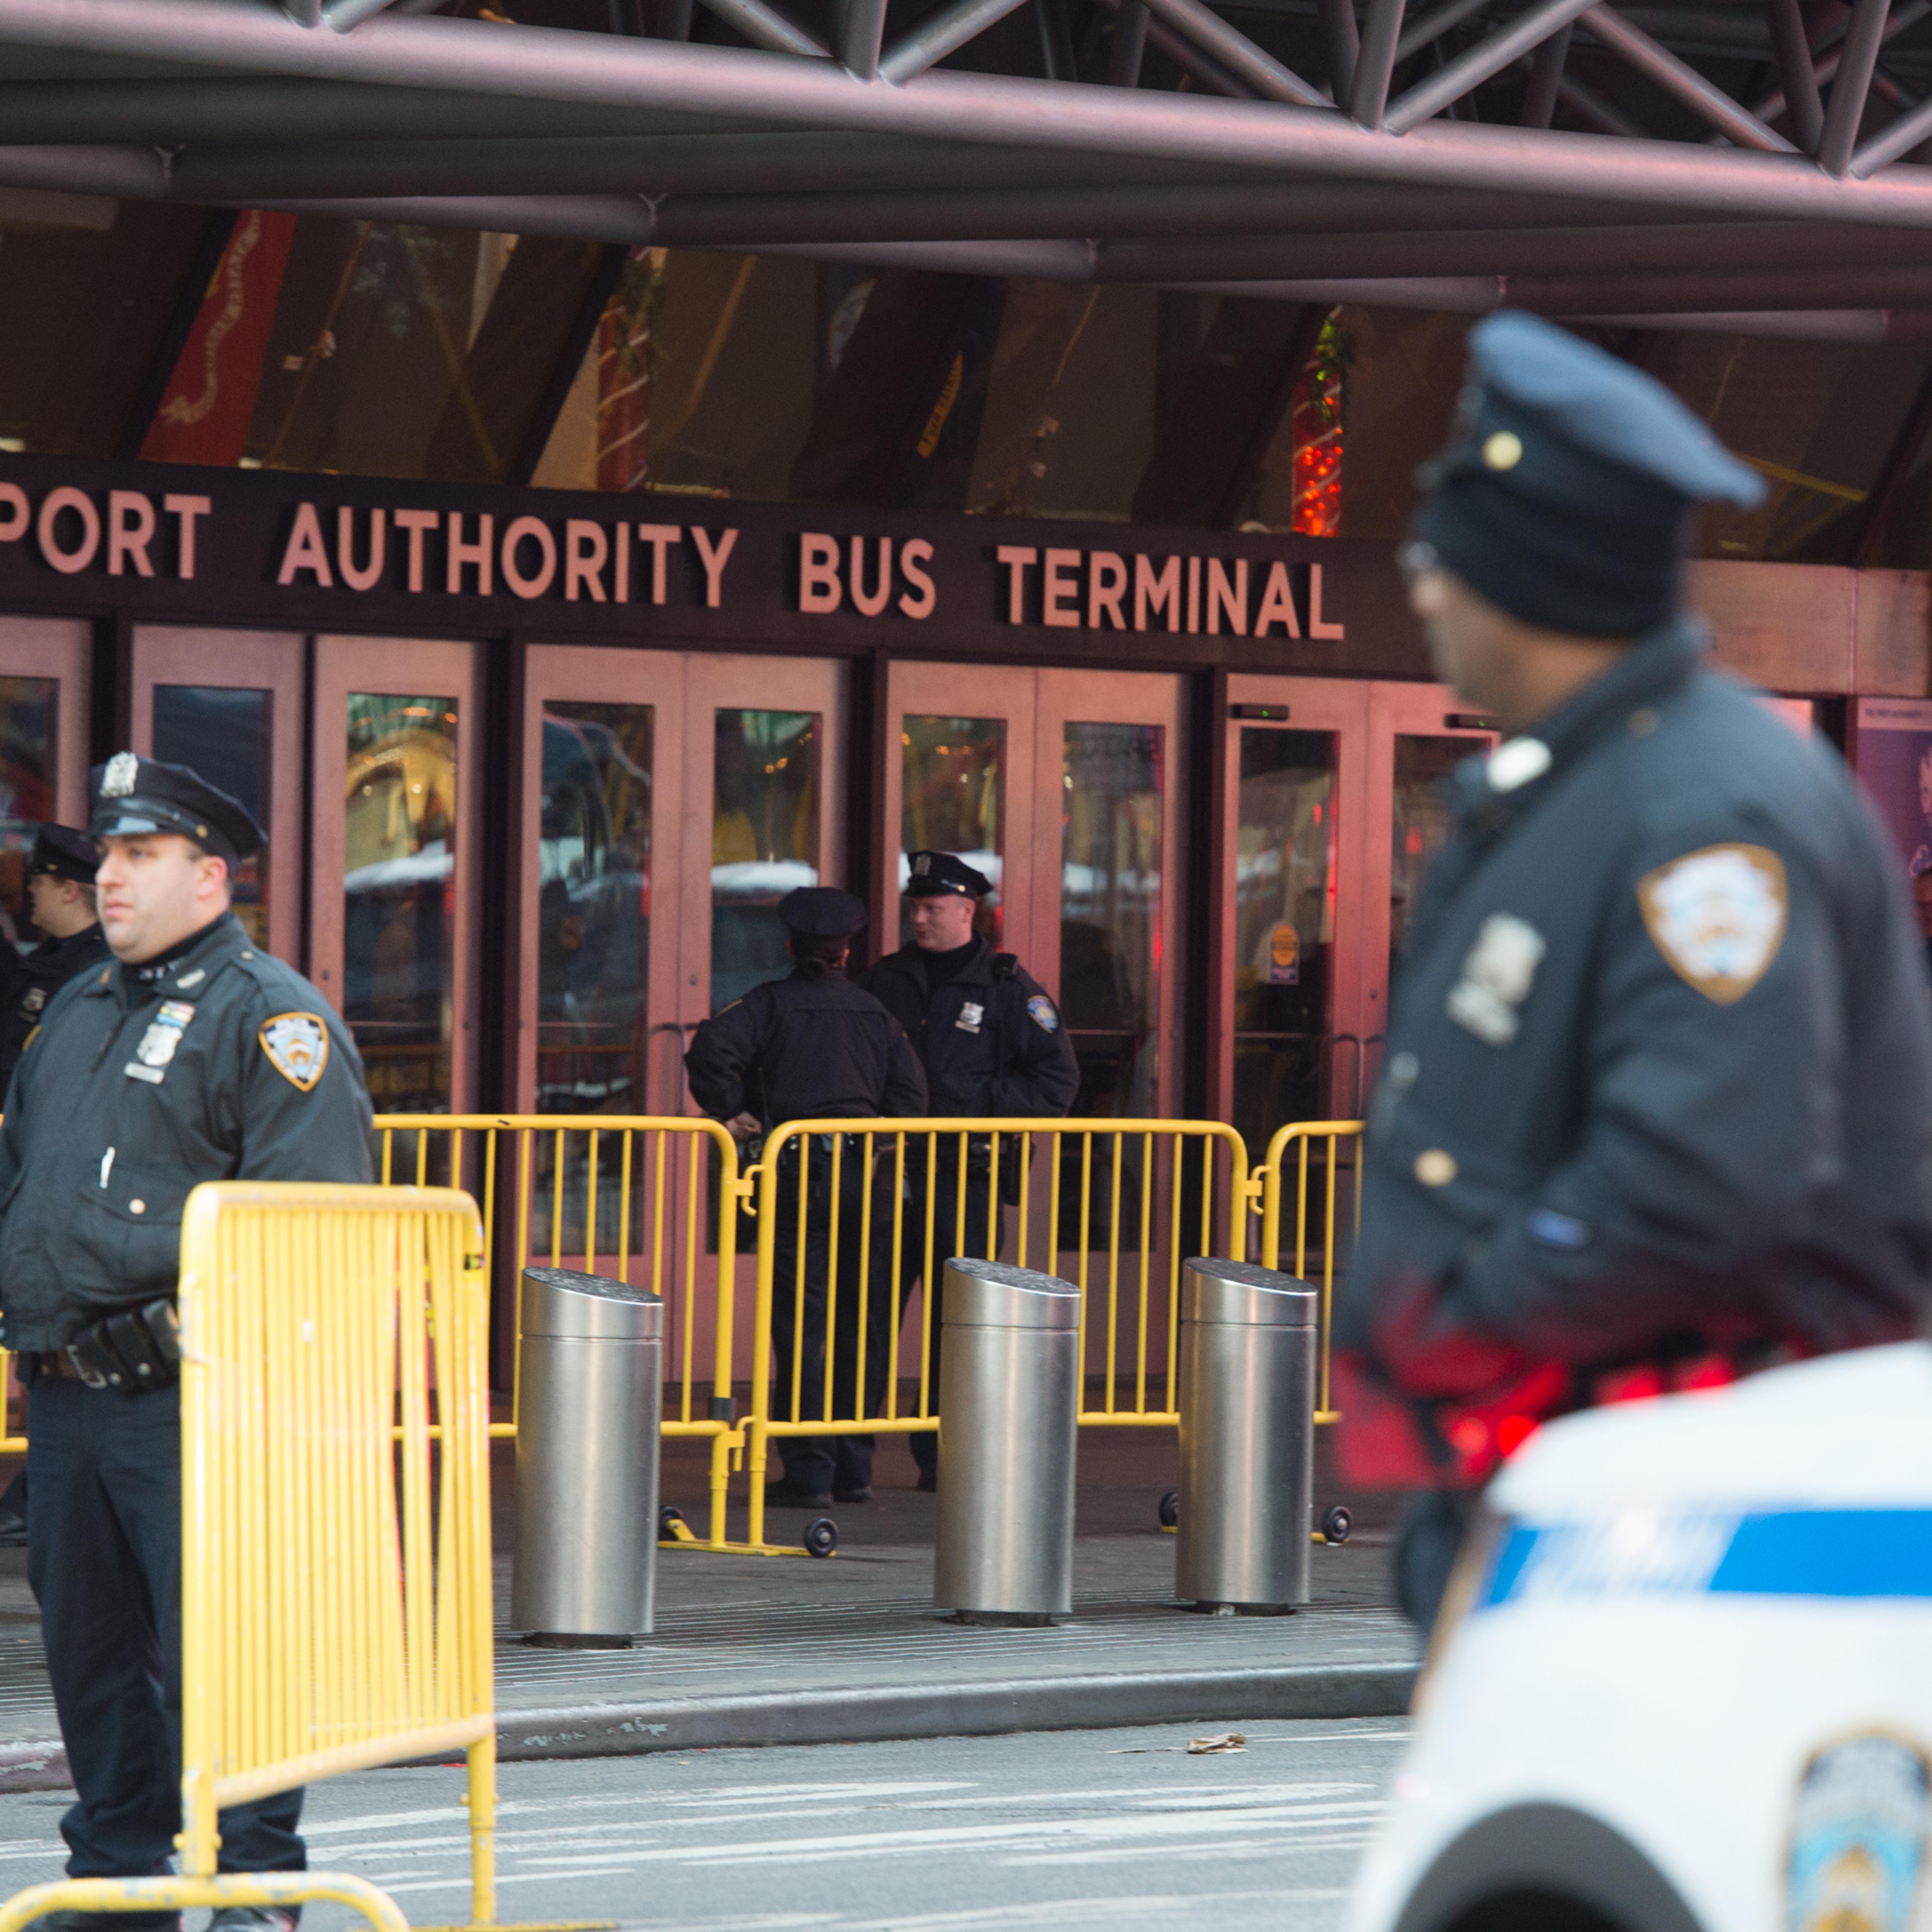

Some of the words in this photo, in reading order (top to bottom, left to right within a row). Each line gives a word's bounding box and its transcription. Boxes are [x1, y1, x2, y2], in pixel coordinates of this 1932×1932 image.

[278, 503, 738, 608] AUTHORITY
[799, 533, 936, 619] BUS
[998, 545, 1345, 641] TERMINAL
